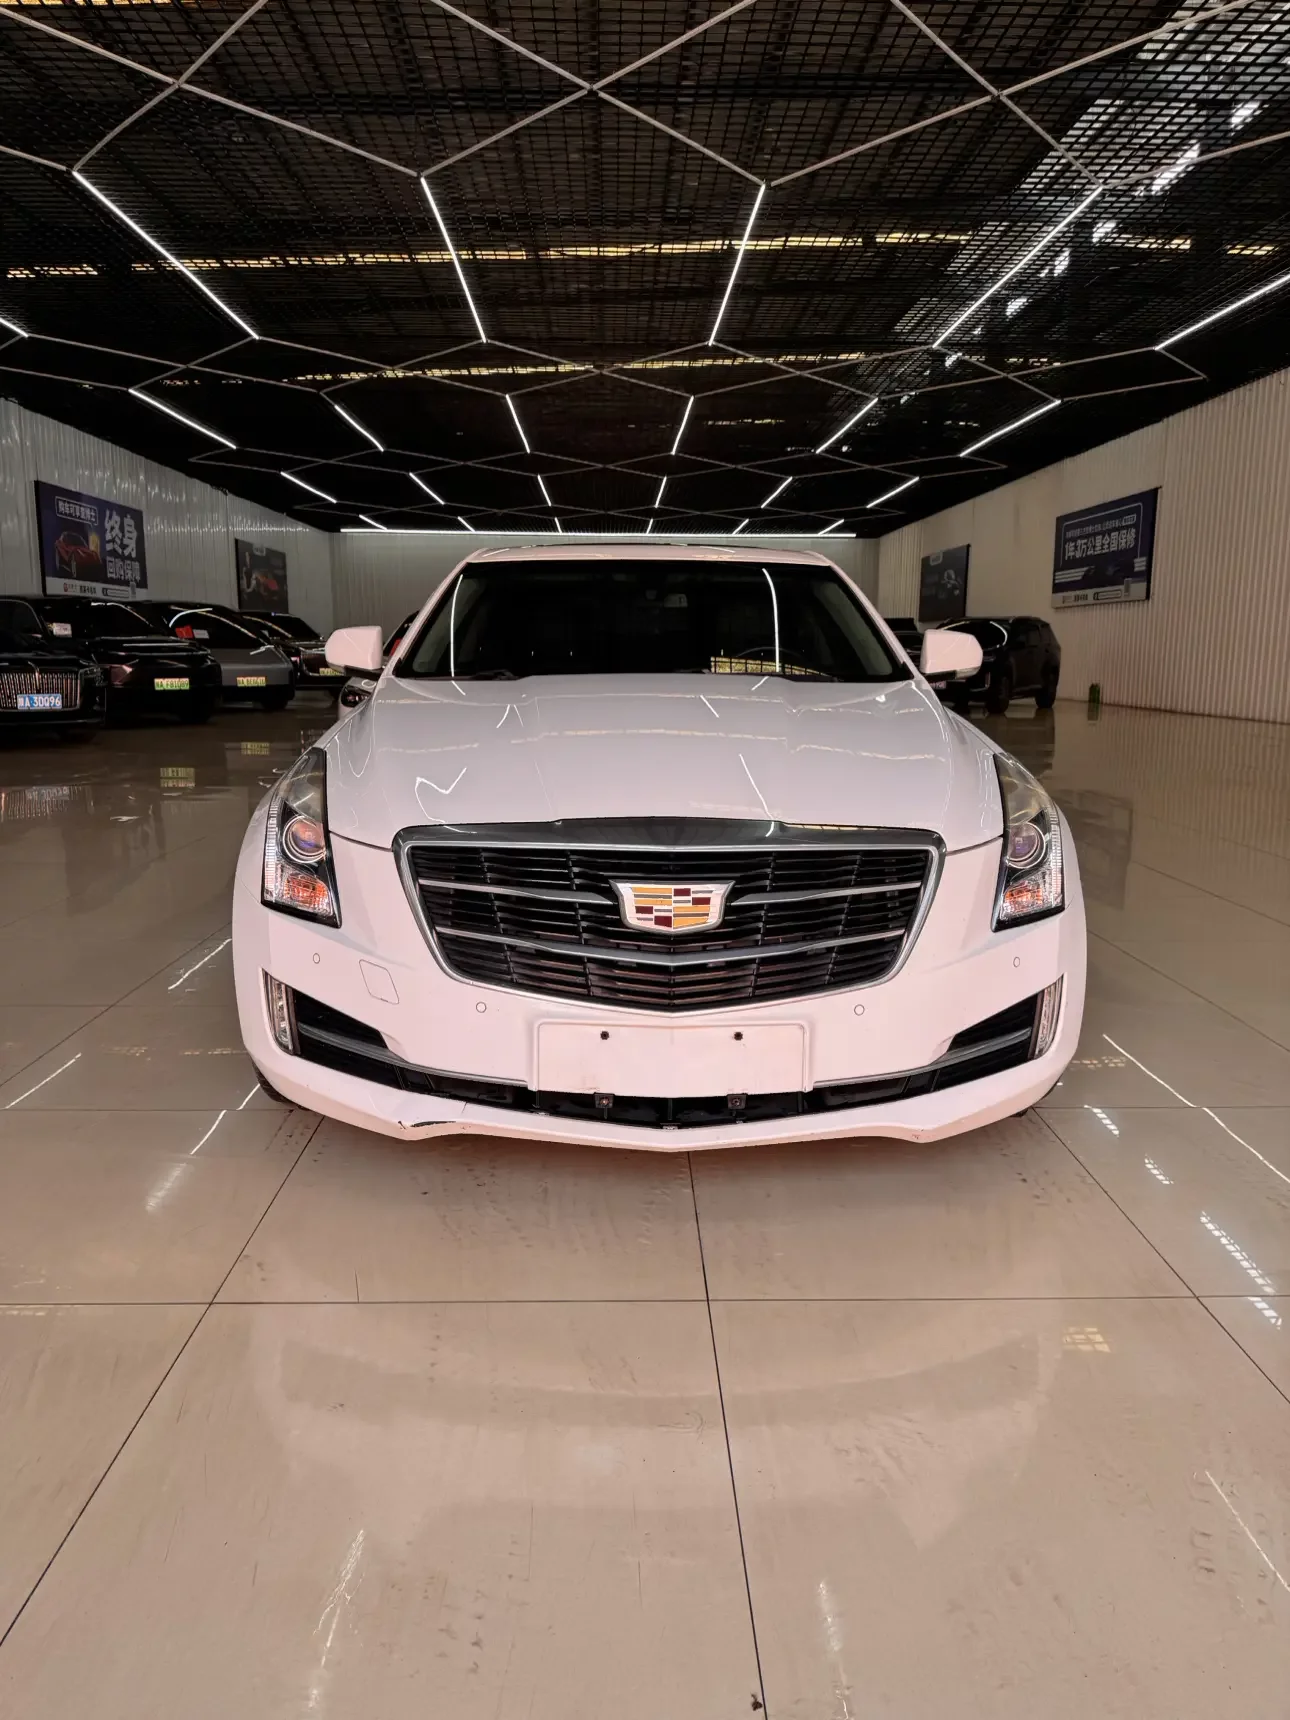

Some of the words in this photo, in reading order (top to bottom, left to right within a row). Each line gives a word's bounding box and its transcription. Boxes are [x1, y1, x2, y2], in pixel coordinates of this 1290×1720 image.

[104, 509, 137, 558] 终身
[106, 556, 141, 583] 回购保障
